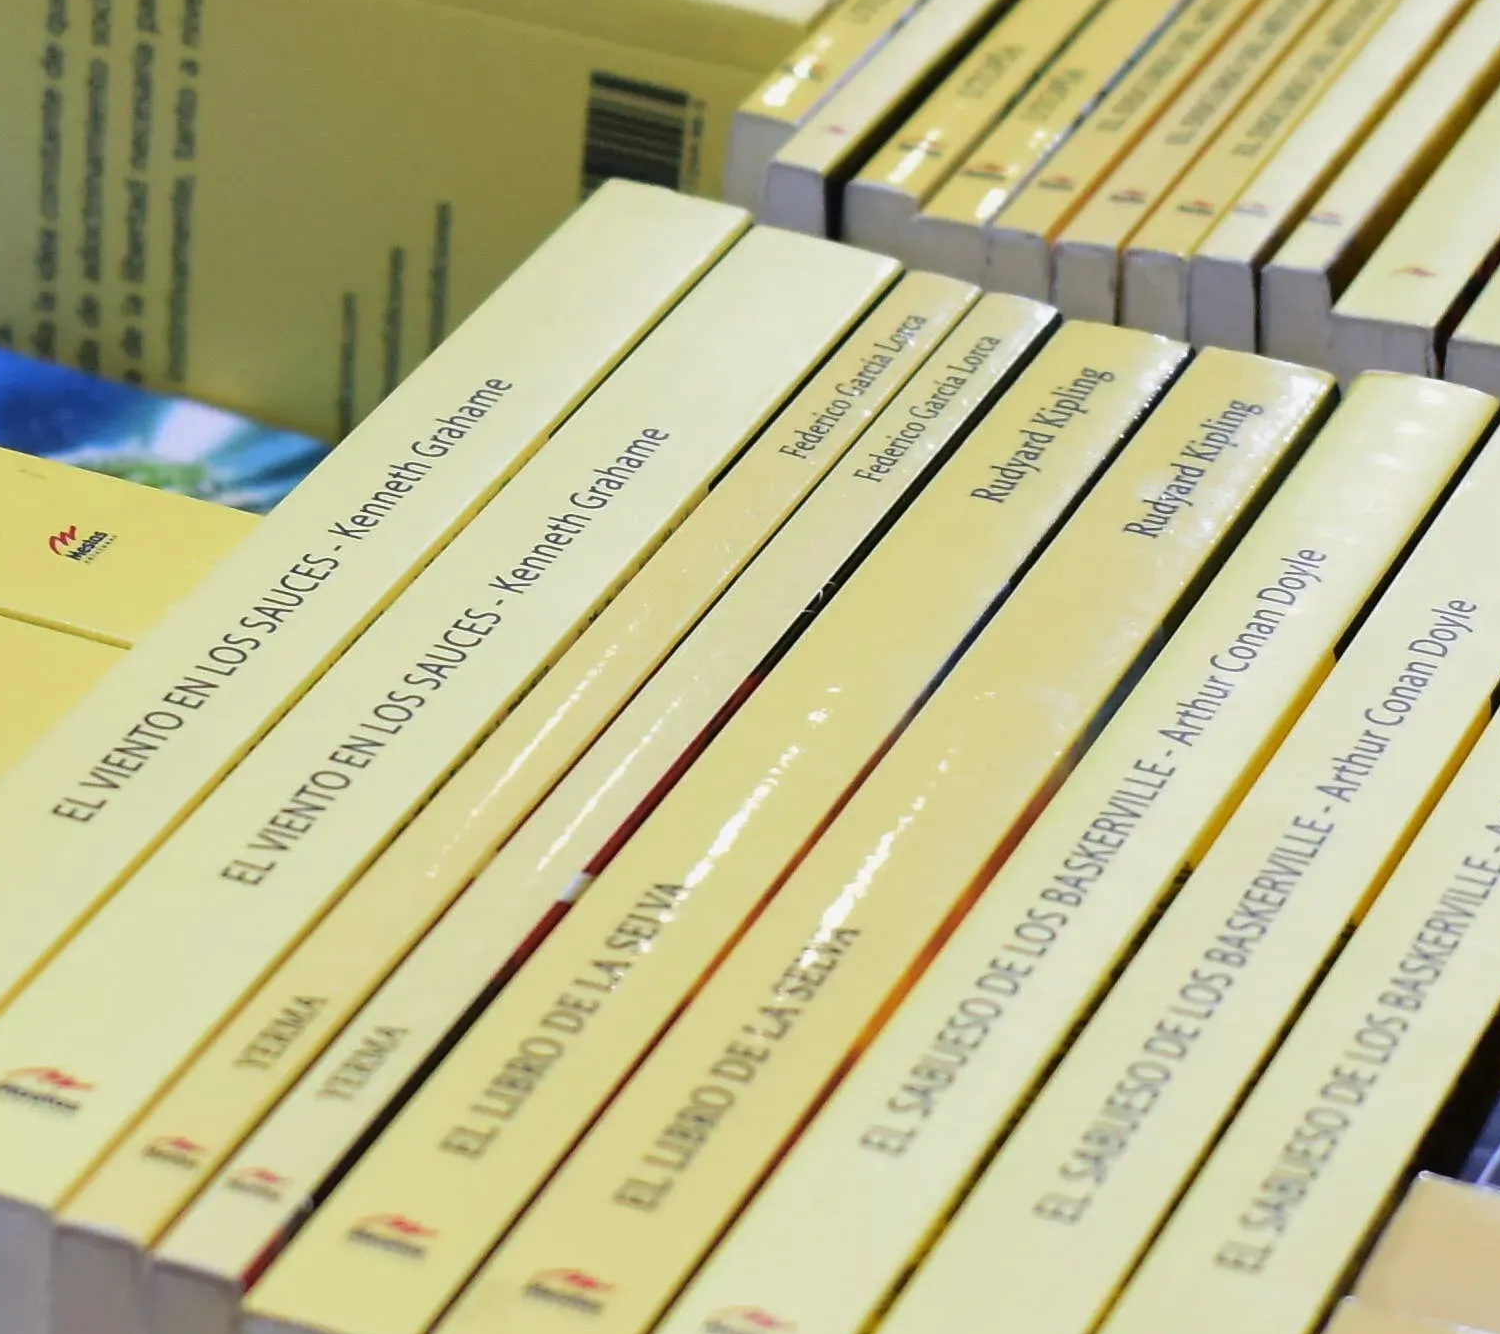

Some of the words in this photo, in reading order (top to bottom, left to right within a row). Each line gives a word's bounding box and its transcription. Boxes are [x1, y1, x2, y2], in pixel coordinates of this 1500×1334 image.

[777, 398, 852, 459] Federico
[834, 353, 894, 397] García
[872, 314, 928, 353] Lorca
[852, 421, 926, 483] Federico
[908, 375, 967, 419] García
[945, 335, 1001, 375] Lorca
[568, 427, 669, 509] Grahame
[969, 428, 1056, 503] Rudyard
[1029, 366, 1115, 429] Kipling
[1122, 462, 1206, 539] Rudyard
[1179, 399, 1264, 463] Kipling
[487, 513, 592, 594] Kenneth
[1255, 548, 1327, 615] Doyle
[50, 797, 107, 823] EL
[79, 710, 184, 802] VIENTO
[161, 676, 219, 710] EN
[194, 632, 261, 676] LOS
[239, 552, 339, 633] SAUCES
[327, 461, 432, 540] Kenneth
[410, 378, 513, 458] Grahame
[1209, 608, 1285, 672] Conan
[402, 607, 502, 690] SAUCES
[359, 689, 426, 735] LOS
[1158, 674, 1233, 747] Arthur
[327, 734, 386, 769] EN
[247, 769, 351, 863] VIENTO
[1039, 758, 1176, 907] BASKERVILLE
[219, 859, 276, 886] EL
[1004, 907, 1068, 958] LOS
[974, 957, 1033, 996] DE
[234, 995, 326, 1070] YERMA
[439, 1126, 498, 1158] EL
[471, 1036, 562, 1119] LIBRO
[539, 995, 599, 1034] DE
[573, 959, 633, 992] LA
[886, 997, 1003, 1118] SABUESO
[859, 1128, 917, 1156] EL
